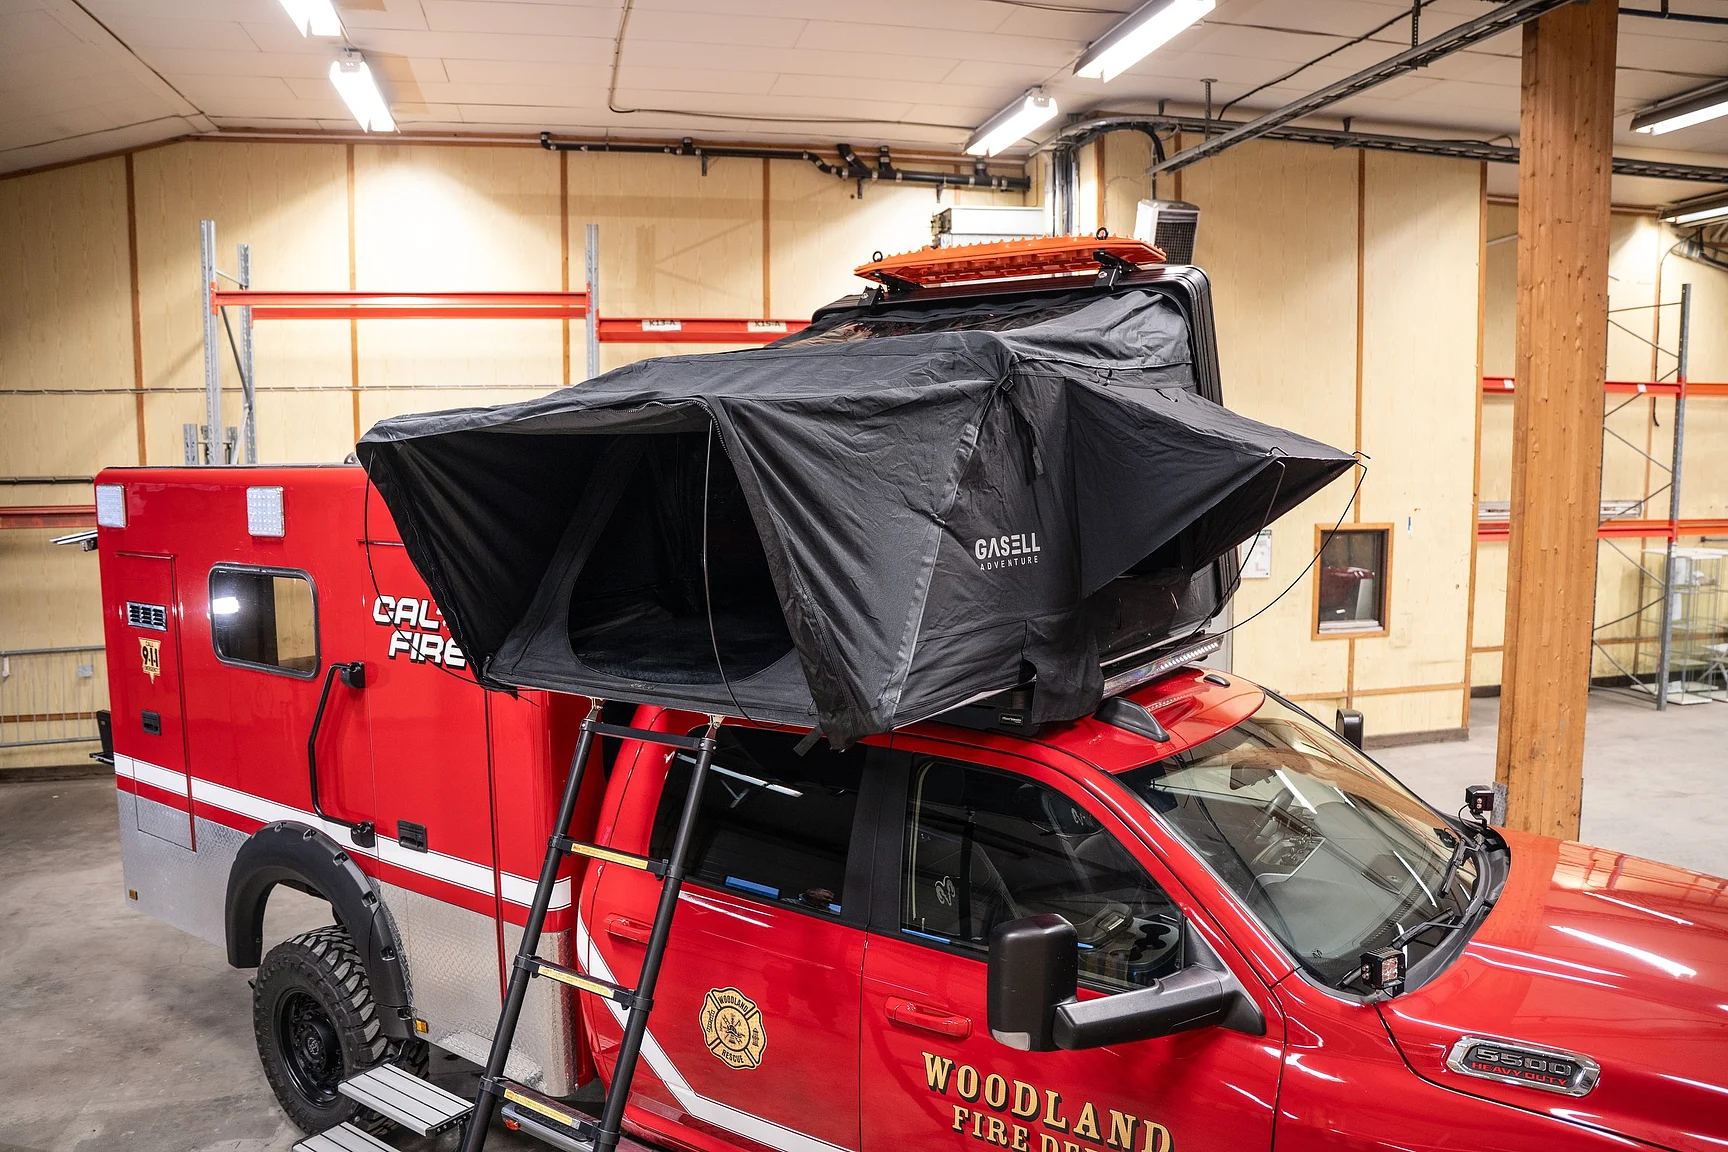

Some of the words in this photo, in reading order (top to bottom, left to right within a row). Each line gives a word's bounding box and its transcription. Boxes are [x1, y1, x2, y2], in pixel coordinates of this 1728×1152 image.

[975, 532, 1040, 560] GASELL
[980, 555, 1039, 571] ADVENTURE
[373, 595, 440, 631] CAL
[388, 629, 467, 670] FIRE
[718, 995, 749, 1012] WOODLAND
[721, 1049, 744, 1063] RESCUE
[1476, 1048, 1572, 1076] 5500
[1471, 1062, 1522, 1077] HEAVY
[1524, 1072, 1568, 1086] DUTY
[921, 1051, 1175, 1152] WOODLAND
[951, 1104, 1031, 1152] FIRE
